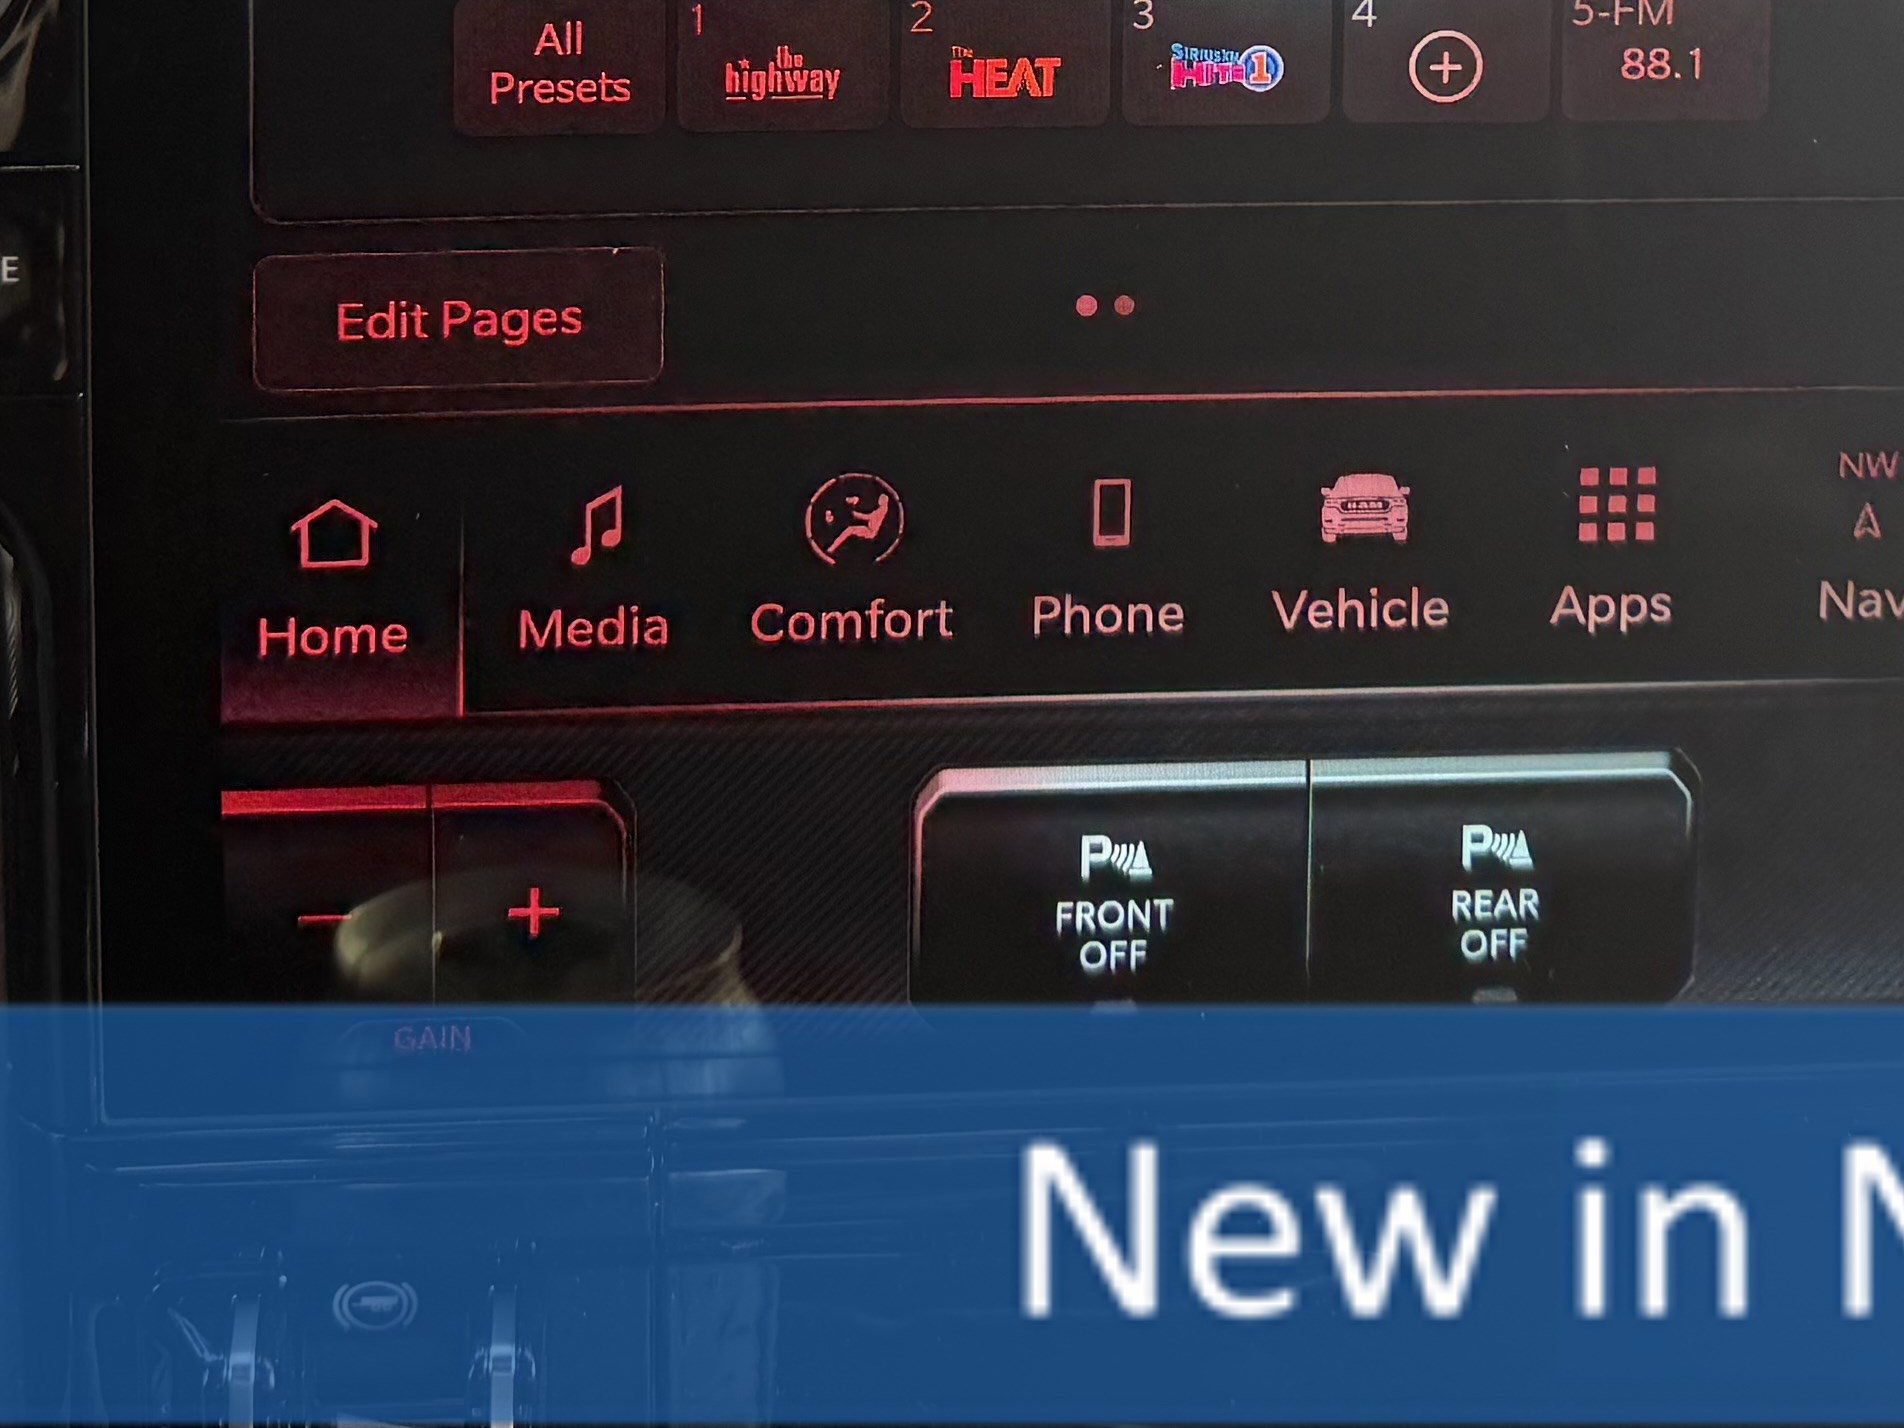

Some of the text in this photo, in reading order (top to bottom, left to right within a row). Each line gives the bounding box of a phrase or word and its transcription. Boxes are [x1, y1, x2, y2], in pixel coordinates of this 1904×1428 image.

[692, 3, 702, 36] 1
[910, 0, 934, 33] 2
[534, 20, 584, 56] All
[777, 45, 804, 69] the
[1250, 51, 1272, 84] 1
[1620, 47, 1702, 81] 88.1
[490, 70, 632, 105] Presets
[725, 59, 841, 101] highway
[950, 57, 1062, 98] HEAT
[337, 299, 582, 347] Edit Pages
[1838, 451, 1901, 480] NW
[751, 599, 954, 644] Comfort
[1032, 594, 1185, 636] Phone
[1271, 586, 1450, 631] Vehicle
[1549, 584, 1673, 628] Apps
[258, 617, 409, 658] Home
[519, 605, 669, 650] Media
[1056, 899, 1174, 936] FRONT
[1452, 888, 1539, 923] REAR
[1079, 940, 1147, 973] OFF
[1461, 927, 1529, 961] OFF
[394, 1024, 472, 1053] GAIN
